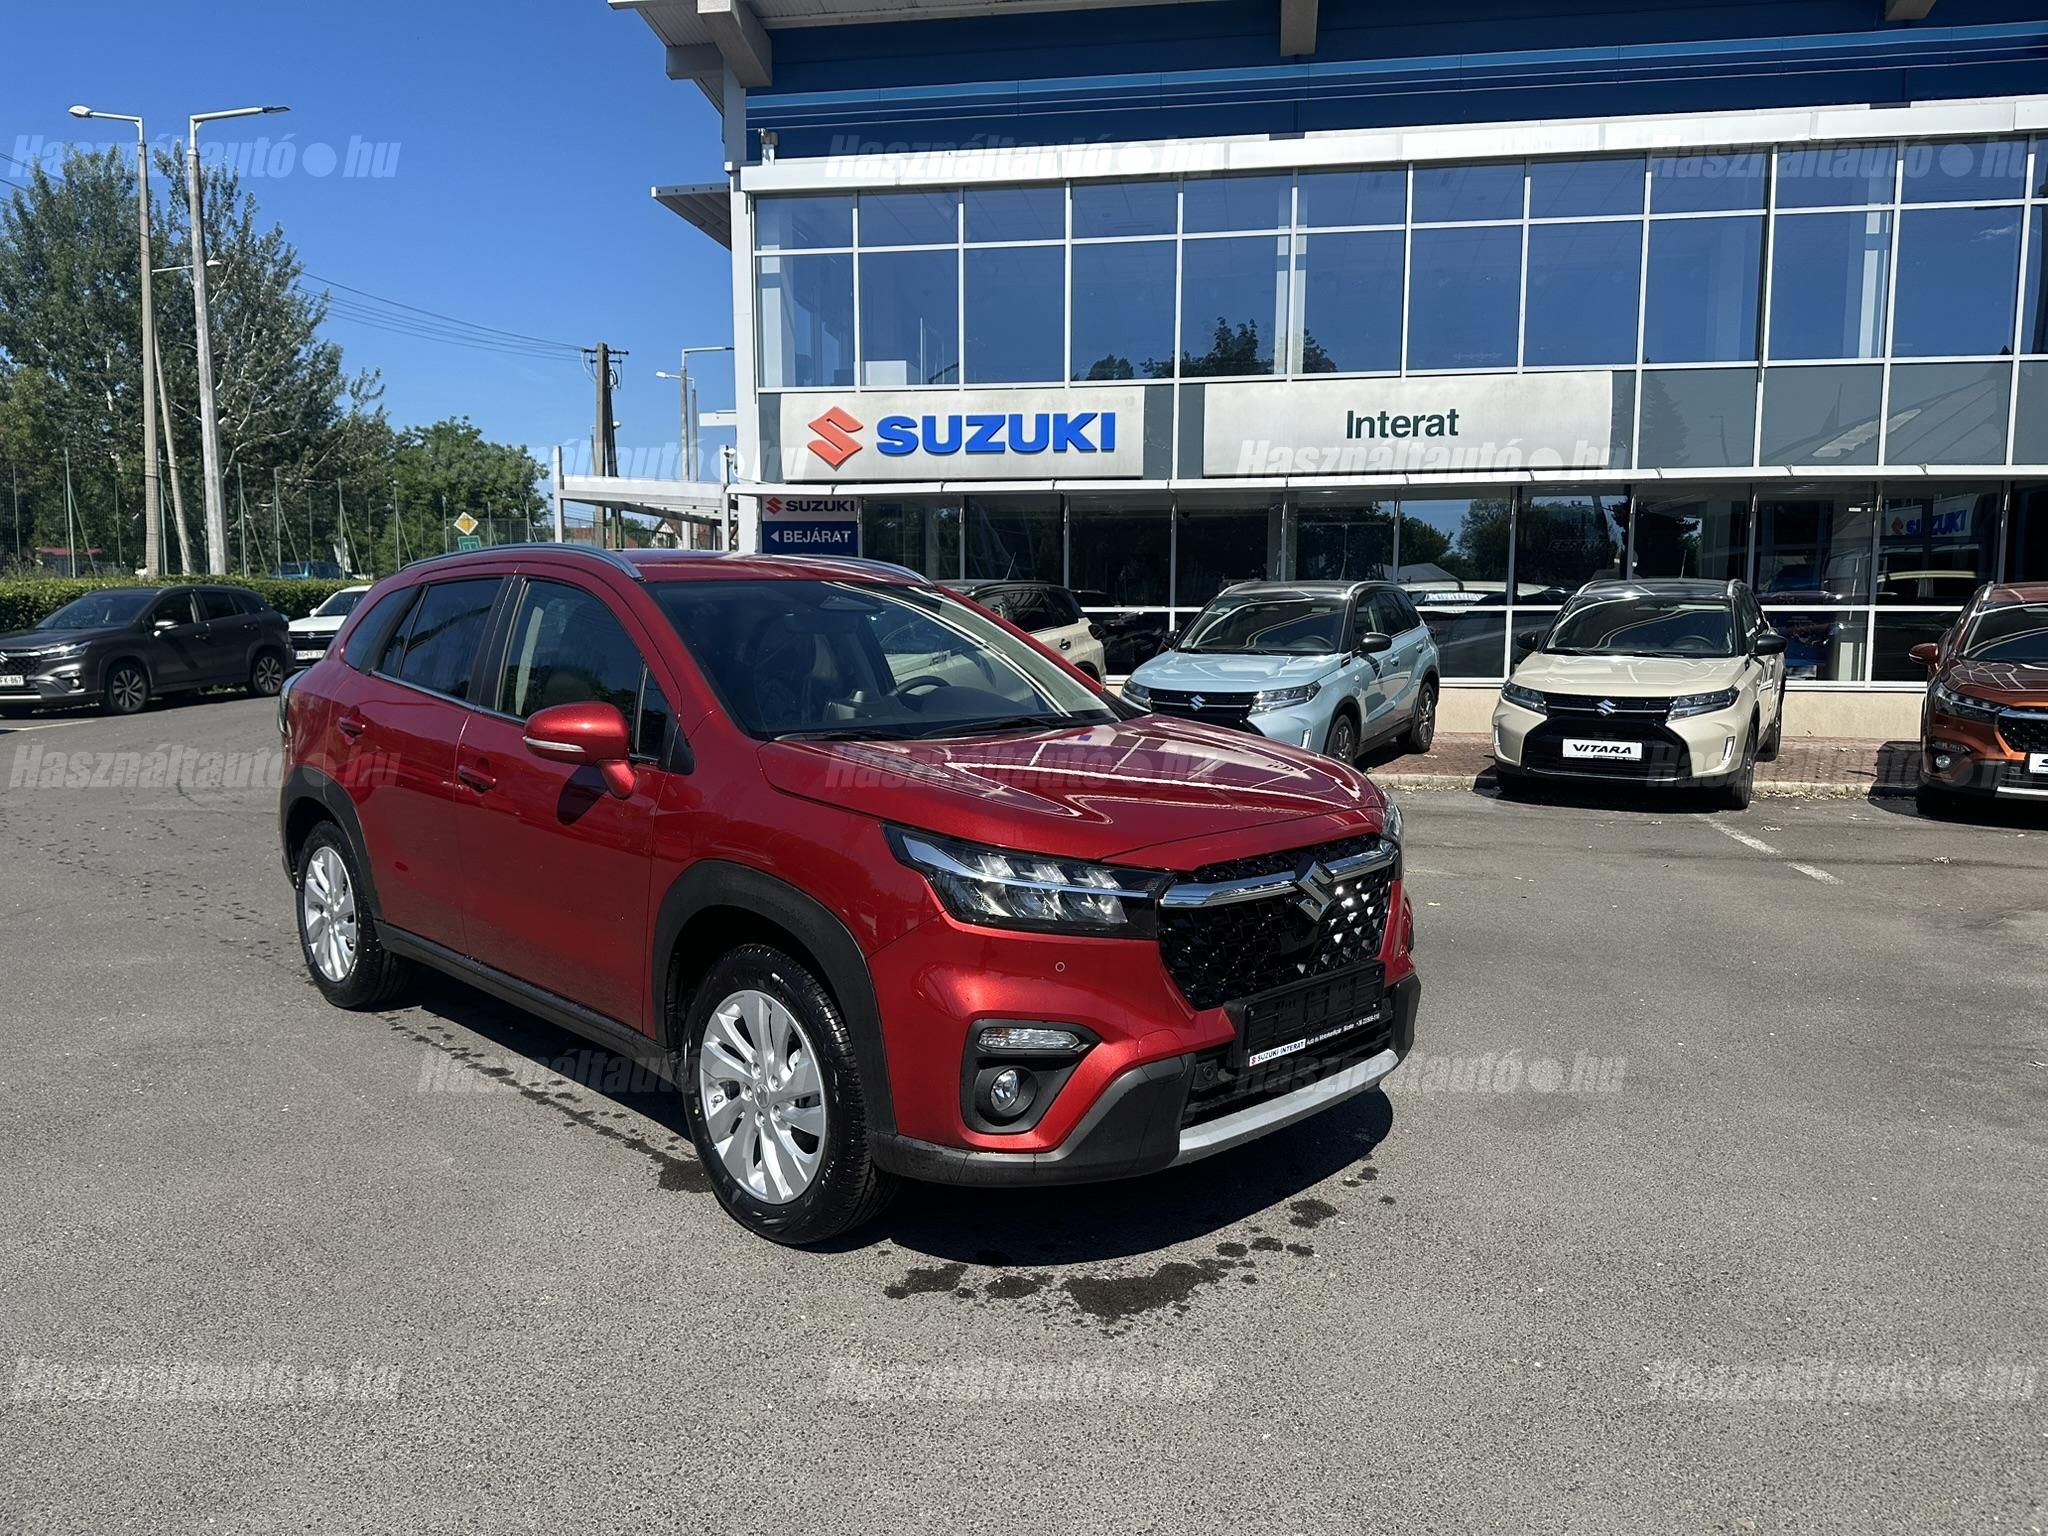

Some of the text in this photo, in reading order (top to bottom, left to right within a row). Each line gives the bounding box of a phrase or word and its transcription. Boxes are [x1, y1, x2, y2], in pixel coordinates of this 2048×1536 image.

[1346, 408, 1460, 439] Interat
[876, 411, 1116, 457] SUZUKI
[785, 500, 855, 512] SUZUKI
[783, 527, 851, 543] BEJÁRAT
[1573, 743, 1631, 754] VITARA
[1257, 1041, 1304, 1062] SUZUKI INTERAT
